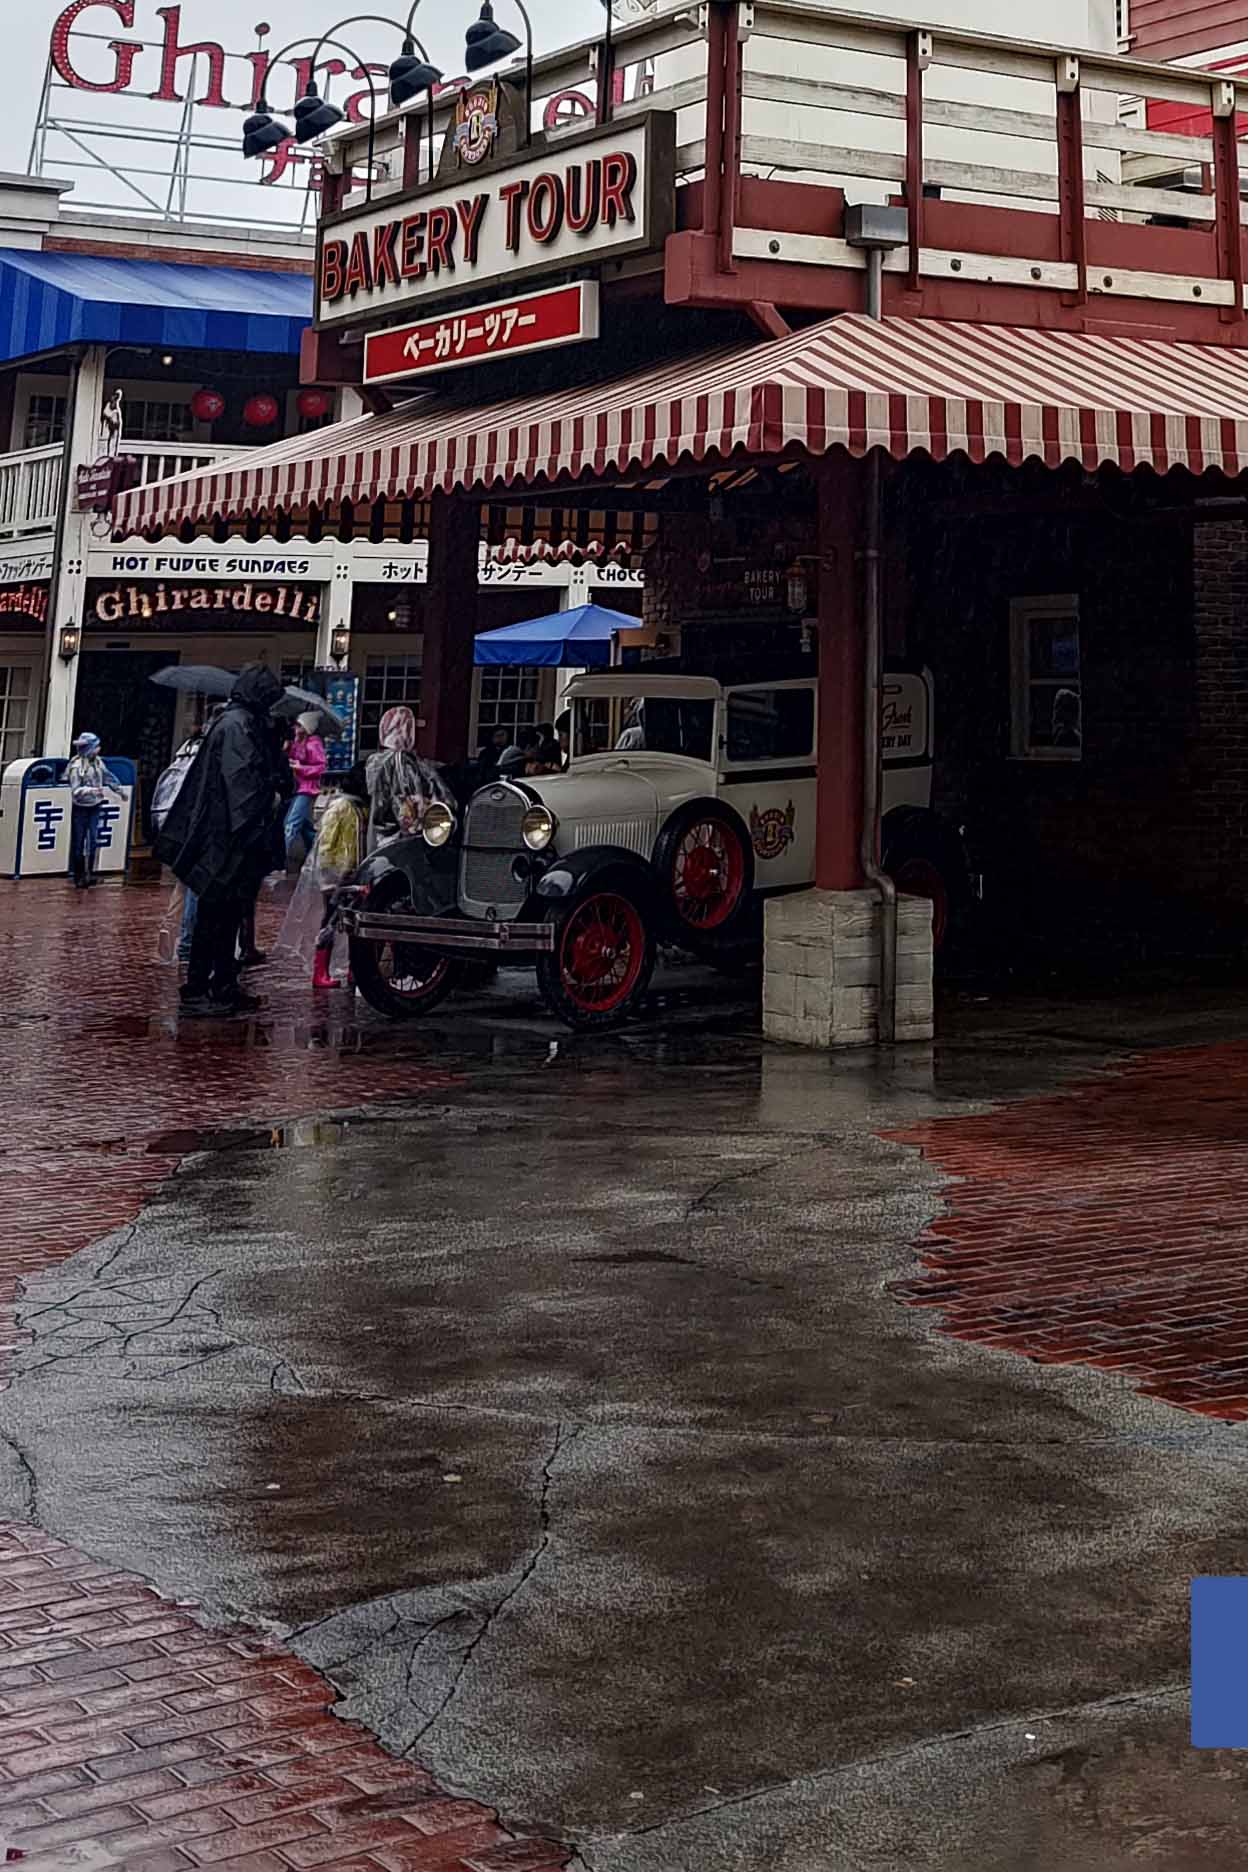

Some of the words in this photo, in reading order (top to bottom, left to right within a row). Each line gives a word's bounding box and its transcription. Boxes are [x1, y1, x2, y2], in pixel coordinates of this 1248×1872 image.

[321, 193, 489, 301] BAKERY
[499, 151, 636, 250] TOUR
[403, 308, 536, 361] ベーカリーツアー
[112, 556, 149, 572] HOT
[155, 557, 219, 573] FUDGE
[225, 558, 310, 575] SUNDAES
[95, 582, 321, 623] Ghirardelli
